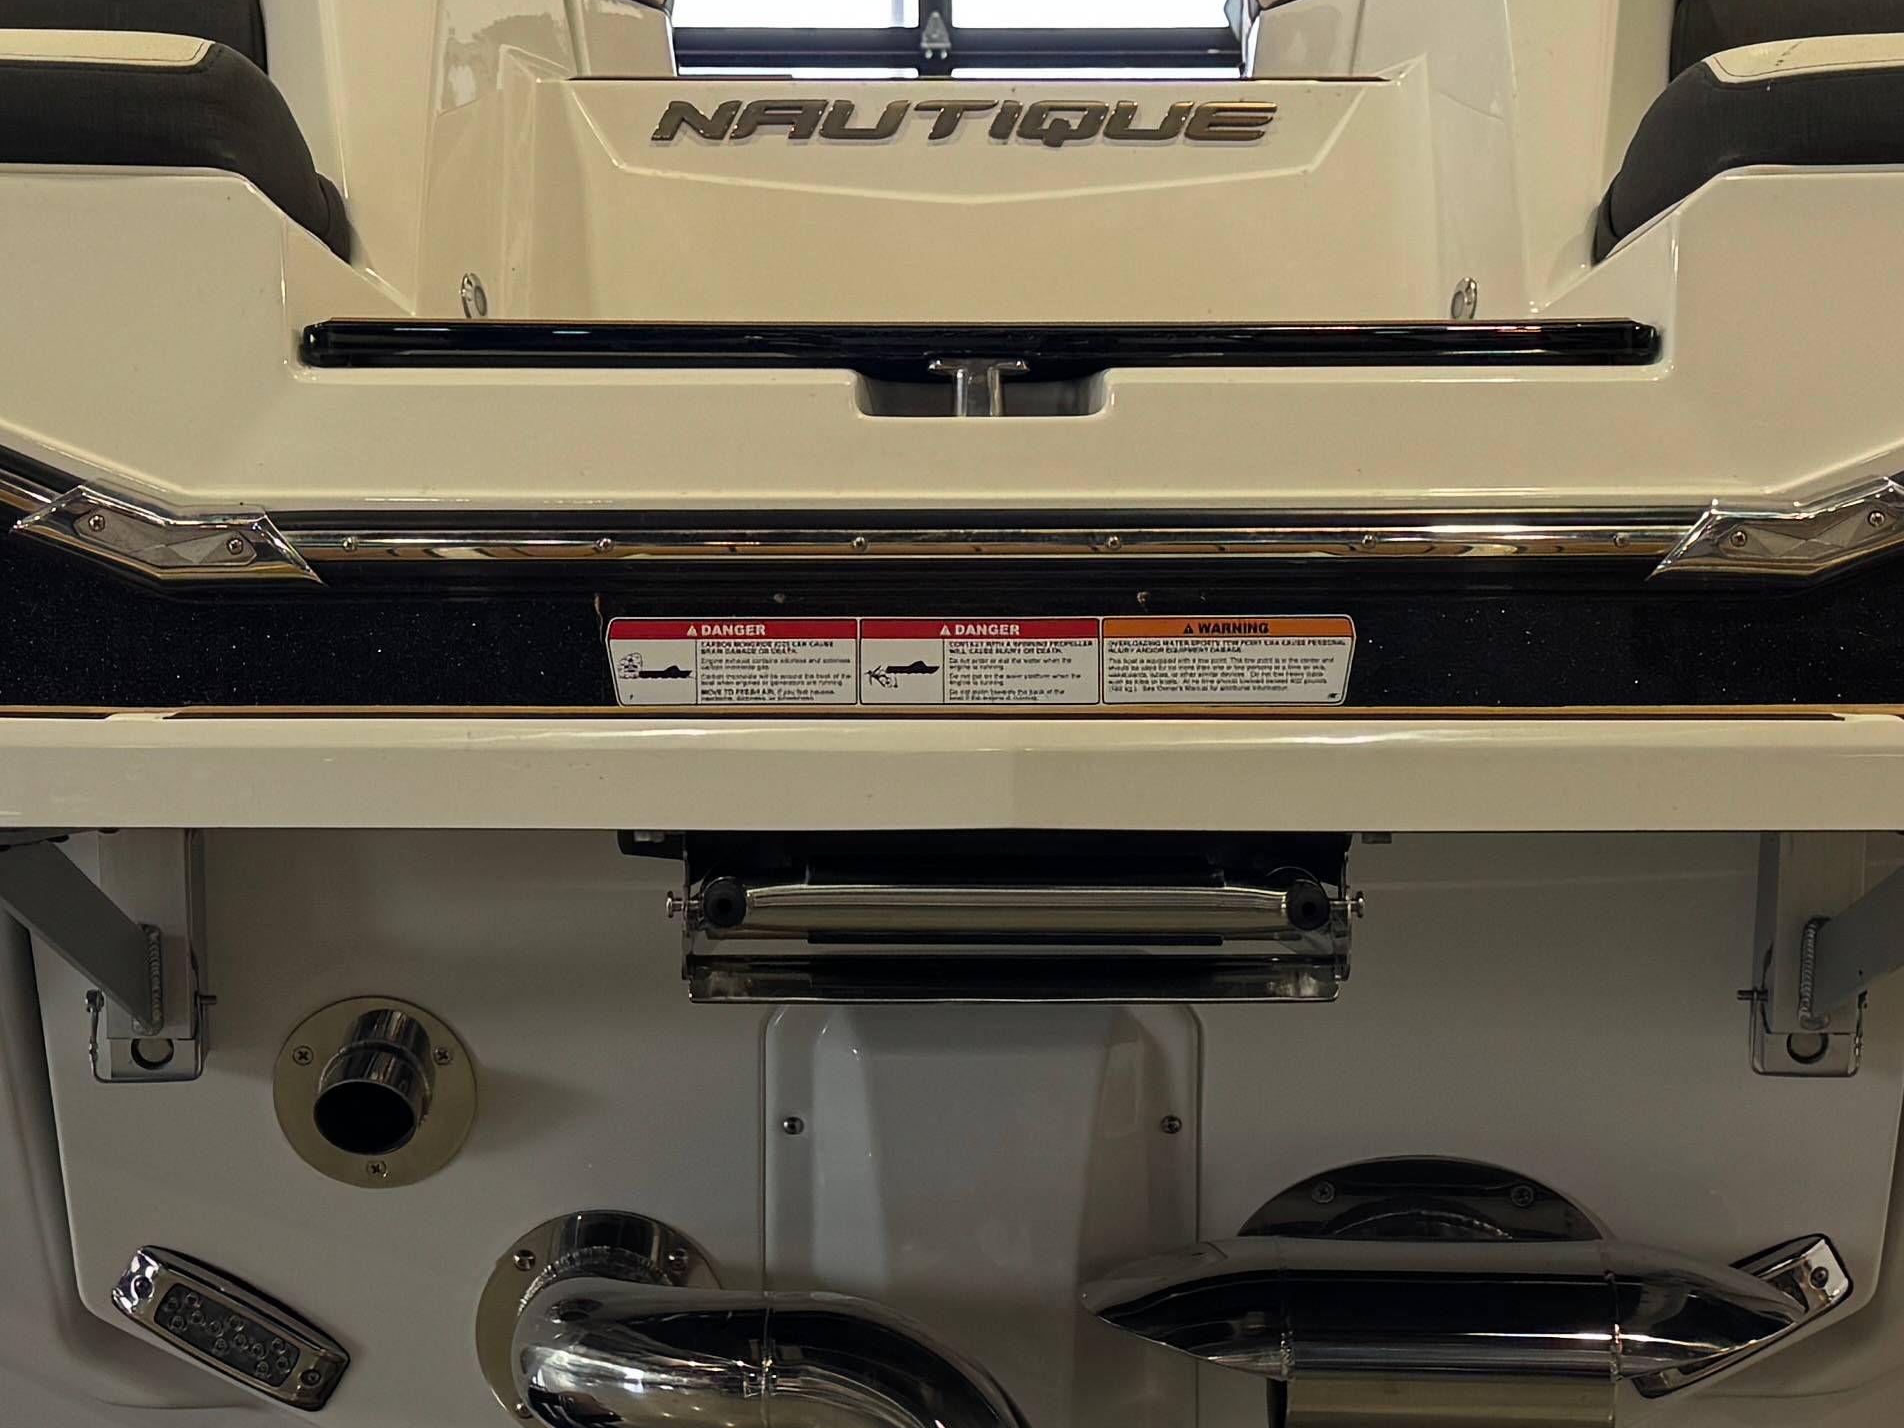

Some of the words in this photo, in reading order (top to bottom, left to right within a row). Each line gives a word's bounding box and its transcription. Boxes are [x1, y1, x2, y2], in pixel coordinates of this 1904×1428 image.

[652, 99, 1278, 147] NAUTIQUE
[701, 624, 766, 636] DANGER
[955, 624, 1020, 636] DANGER
[1198, 622, 1269, 635] WARNING
